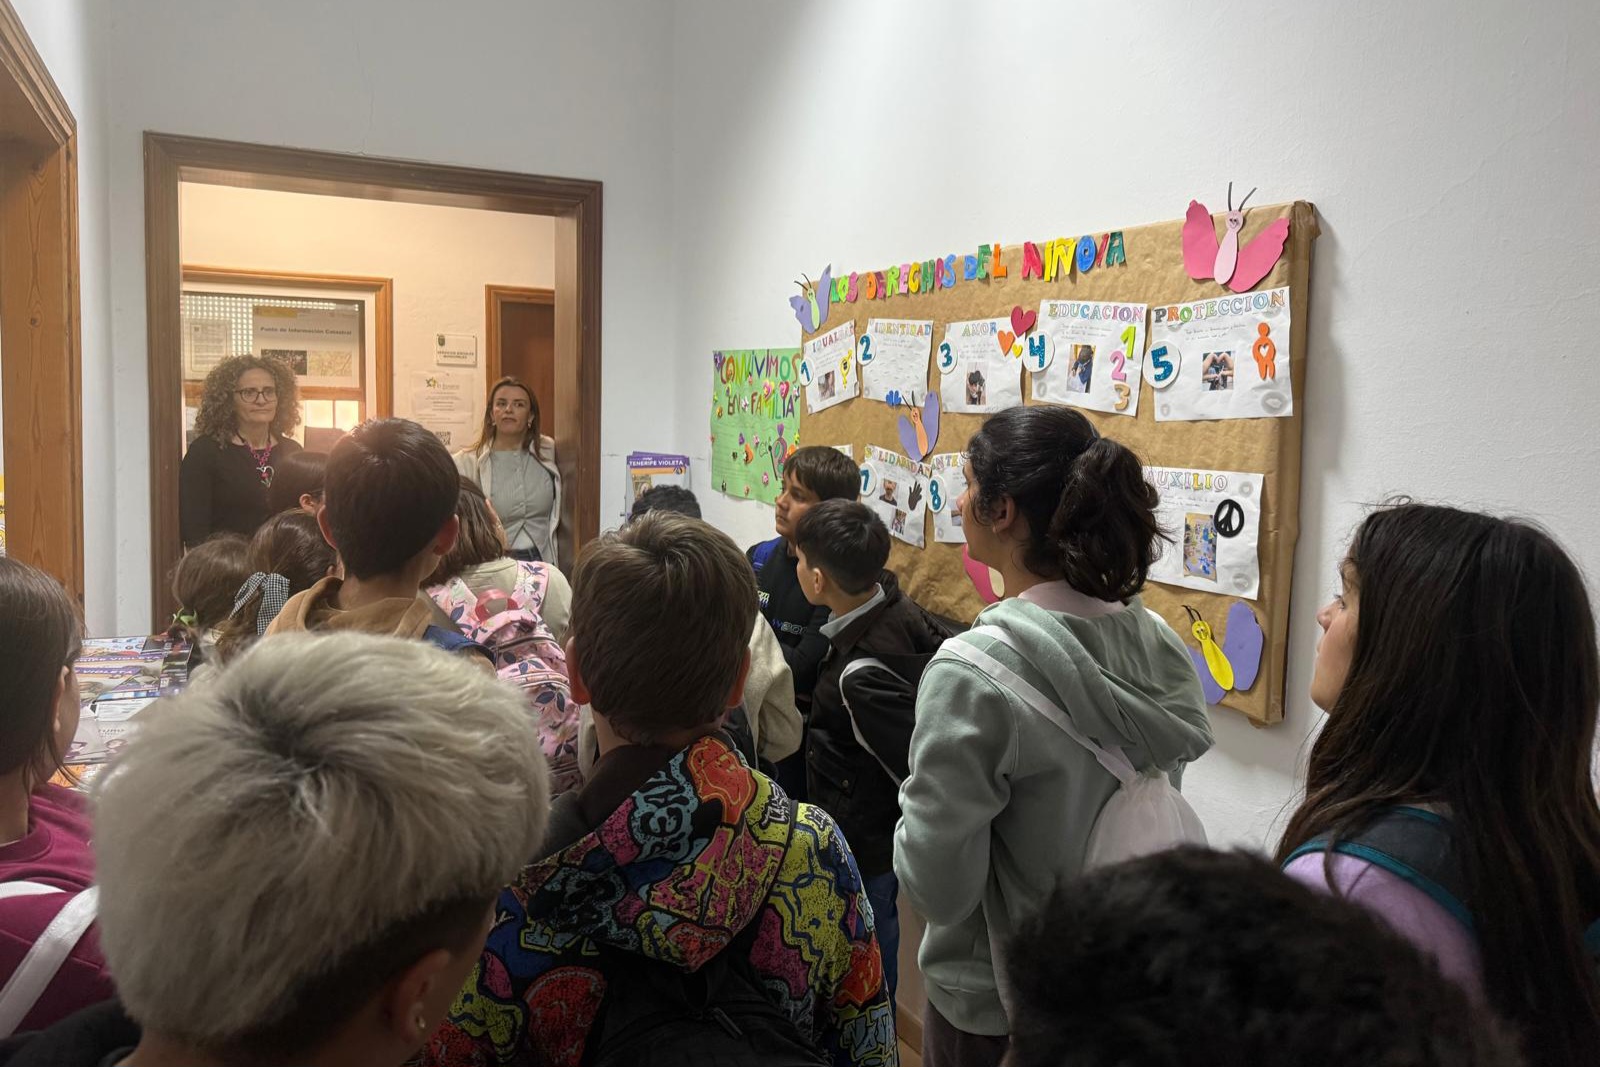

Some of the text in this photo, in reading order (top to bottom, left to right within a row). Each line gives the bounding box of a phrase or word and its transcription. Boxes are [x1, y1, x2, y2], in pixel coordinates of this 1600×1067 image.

[831, 271, 858, 303] LOS
[866, 254, 957, 301] DERECHOS
[964, 243, 1007, 280] DEL
[1048, 303, 1144, 323] EDUCACION
[1153, 289, 1285, 323] PROTECCION
[875, 322, 932, 336] IDENTIDAD
[962, 322, 997, 336] AMOR
[860, 335, 872, 361] 2
[940, 343, 952, 367] 3
[1029, 335, 1045, 368] 4
[1121, 326, 1136, 360] 1
[801, 361, 811, 382] 1
[1110, 351, 1126, 381] 2
[1151, 346, 1173, 382] 5
[1114, 383, 1130, 410] 3
[629, 459, 658, 467] TENERIFE
[860, 469, 870, 492] 7
[930, 480, 942, 510] 8
